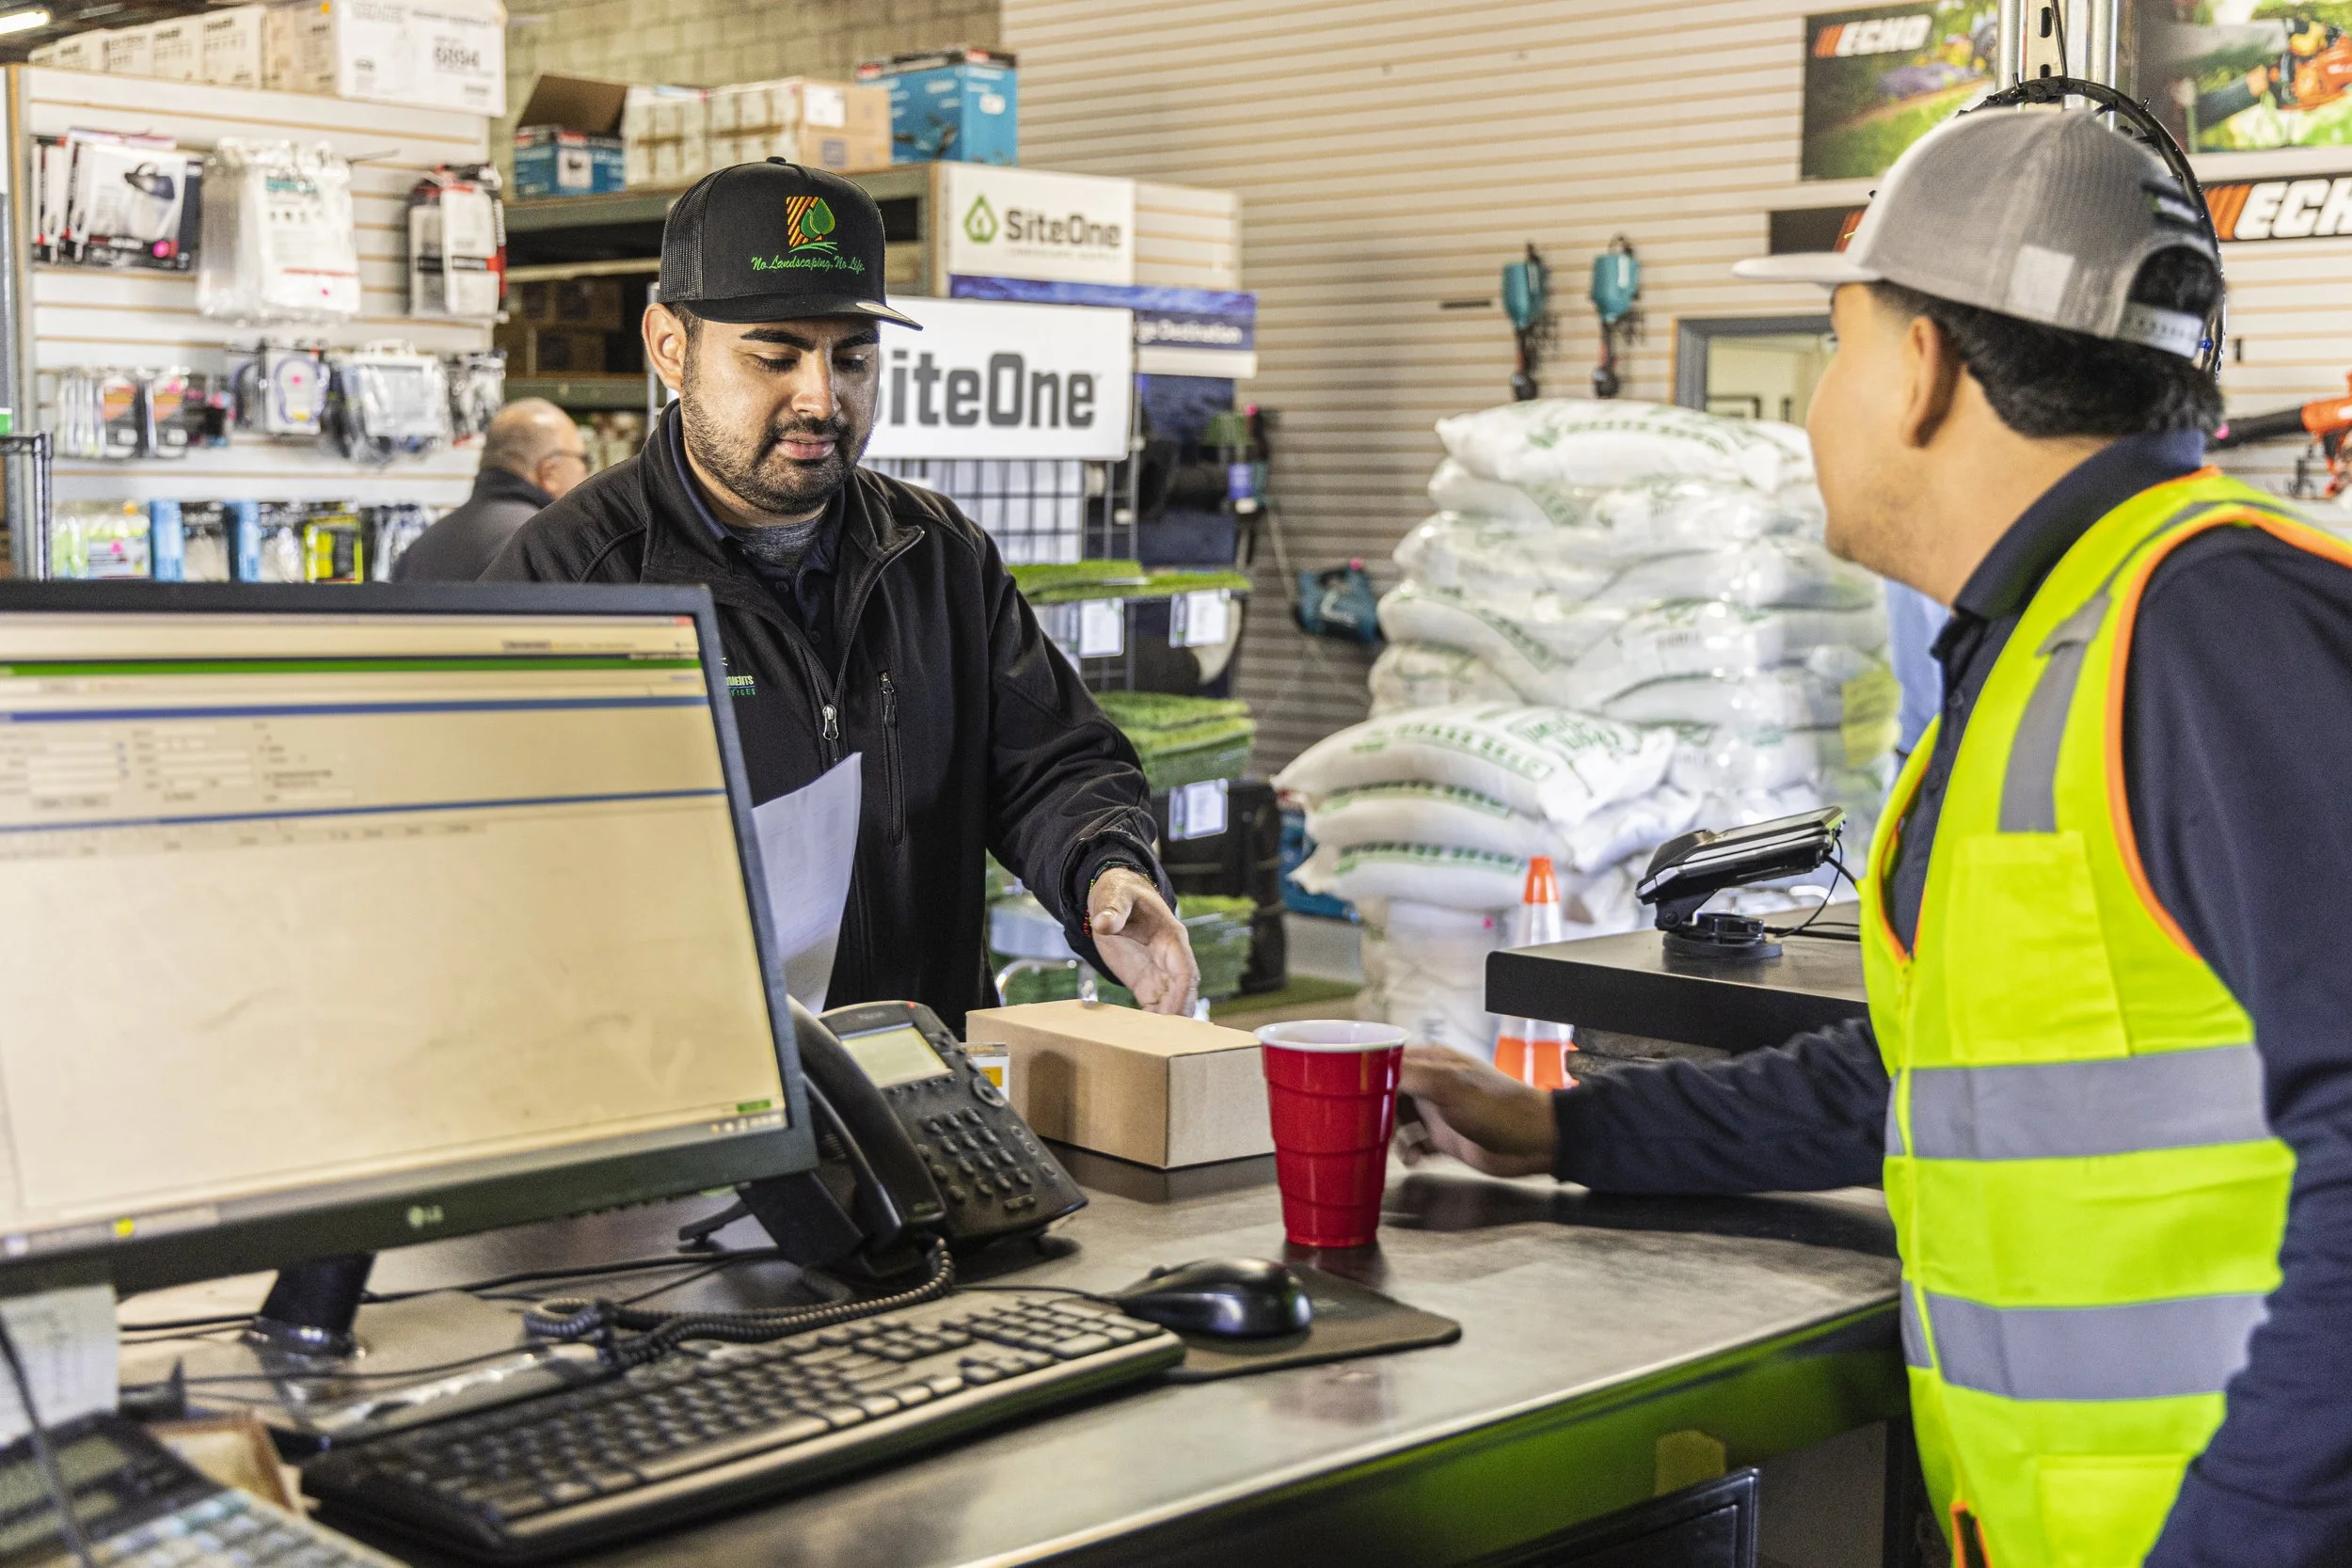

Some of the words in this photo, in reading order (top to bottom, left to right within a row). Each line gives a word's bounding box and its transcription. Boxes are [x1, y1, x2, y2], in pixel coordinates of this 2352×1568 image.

[1836, 13, 1932, 57] ECHO
[1006, 209, 1122, 248] SiteOne
[751, 257, 767, 270] No
[834, 255, 847, 268] No
[879, 349, 1095, 430] iteOne
